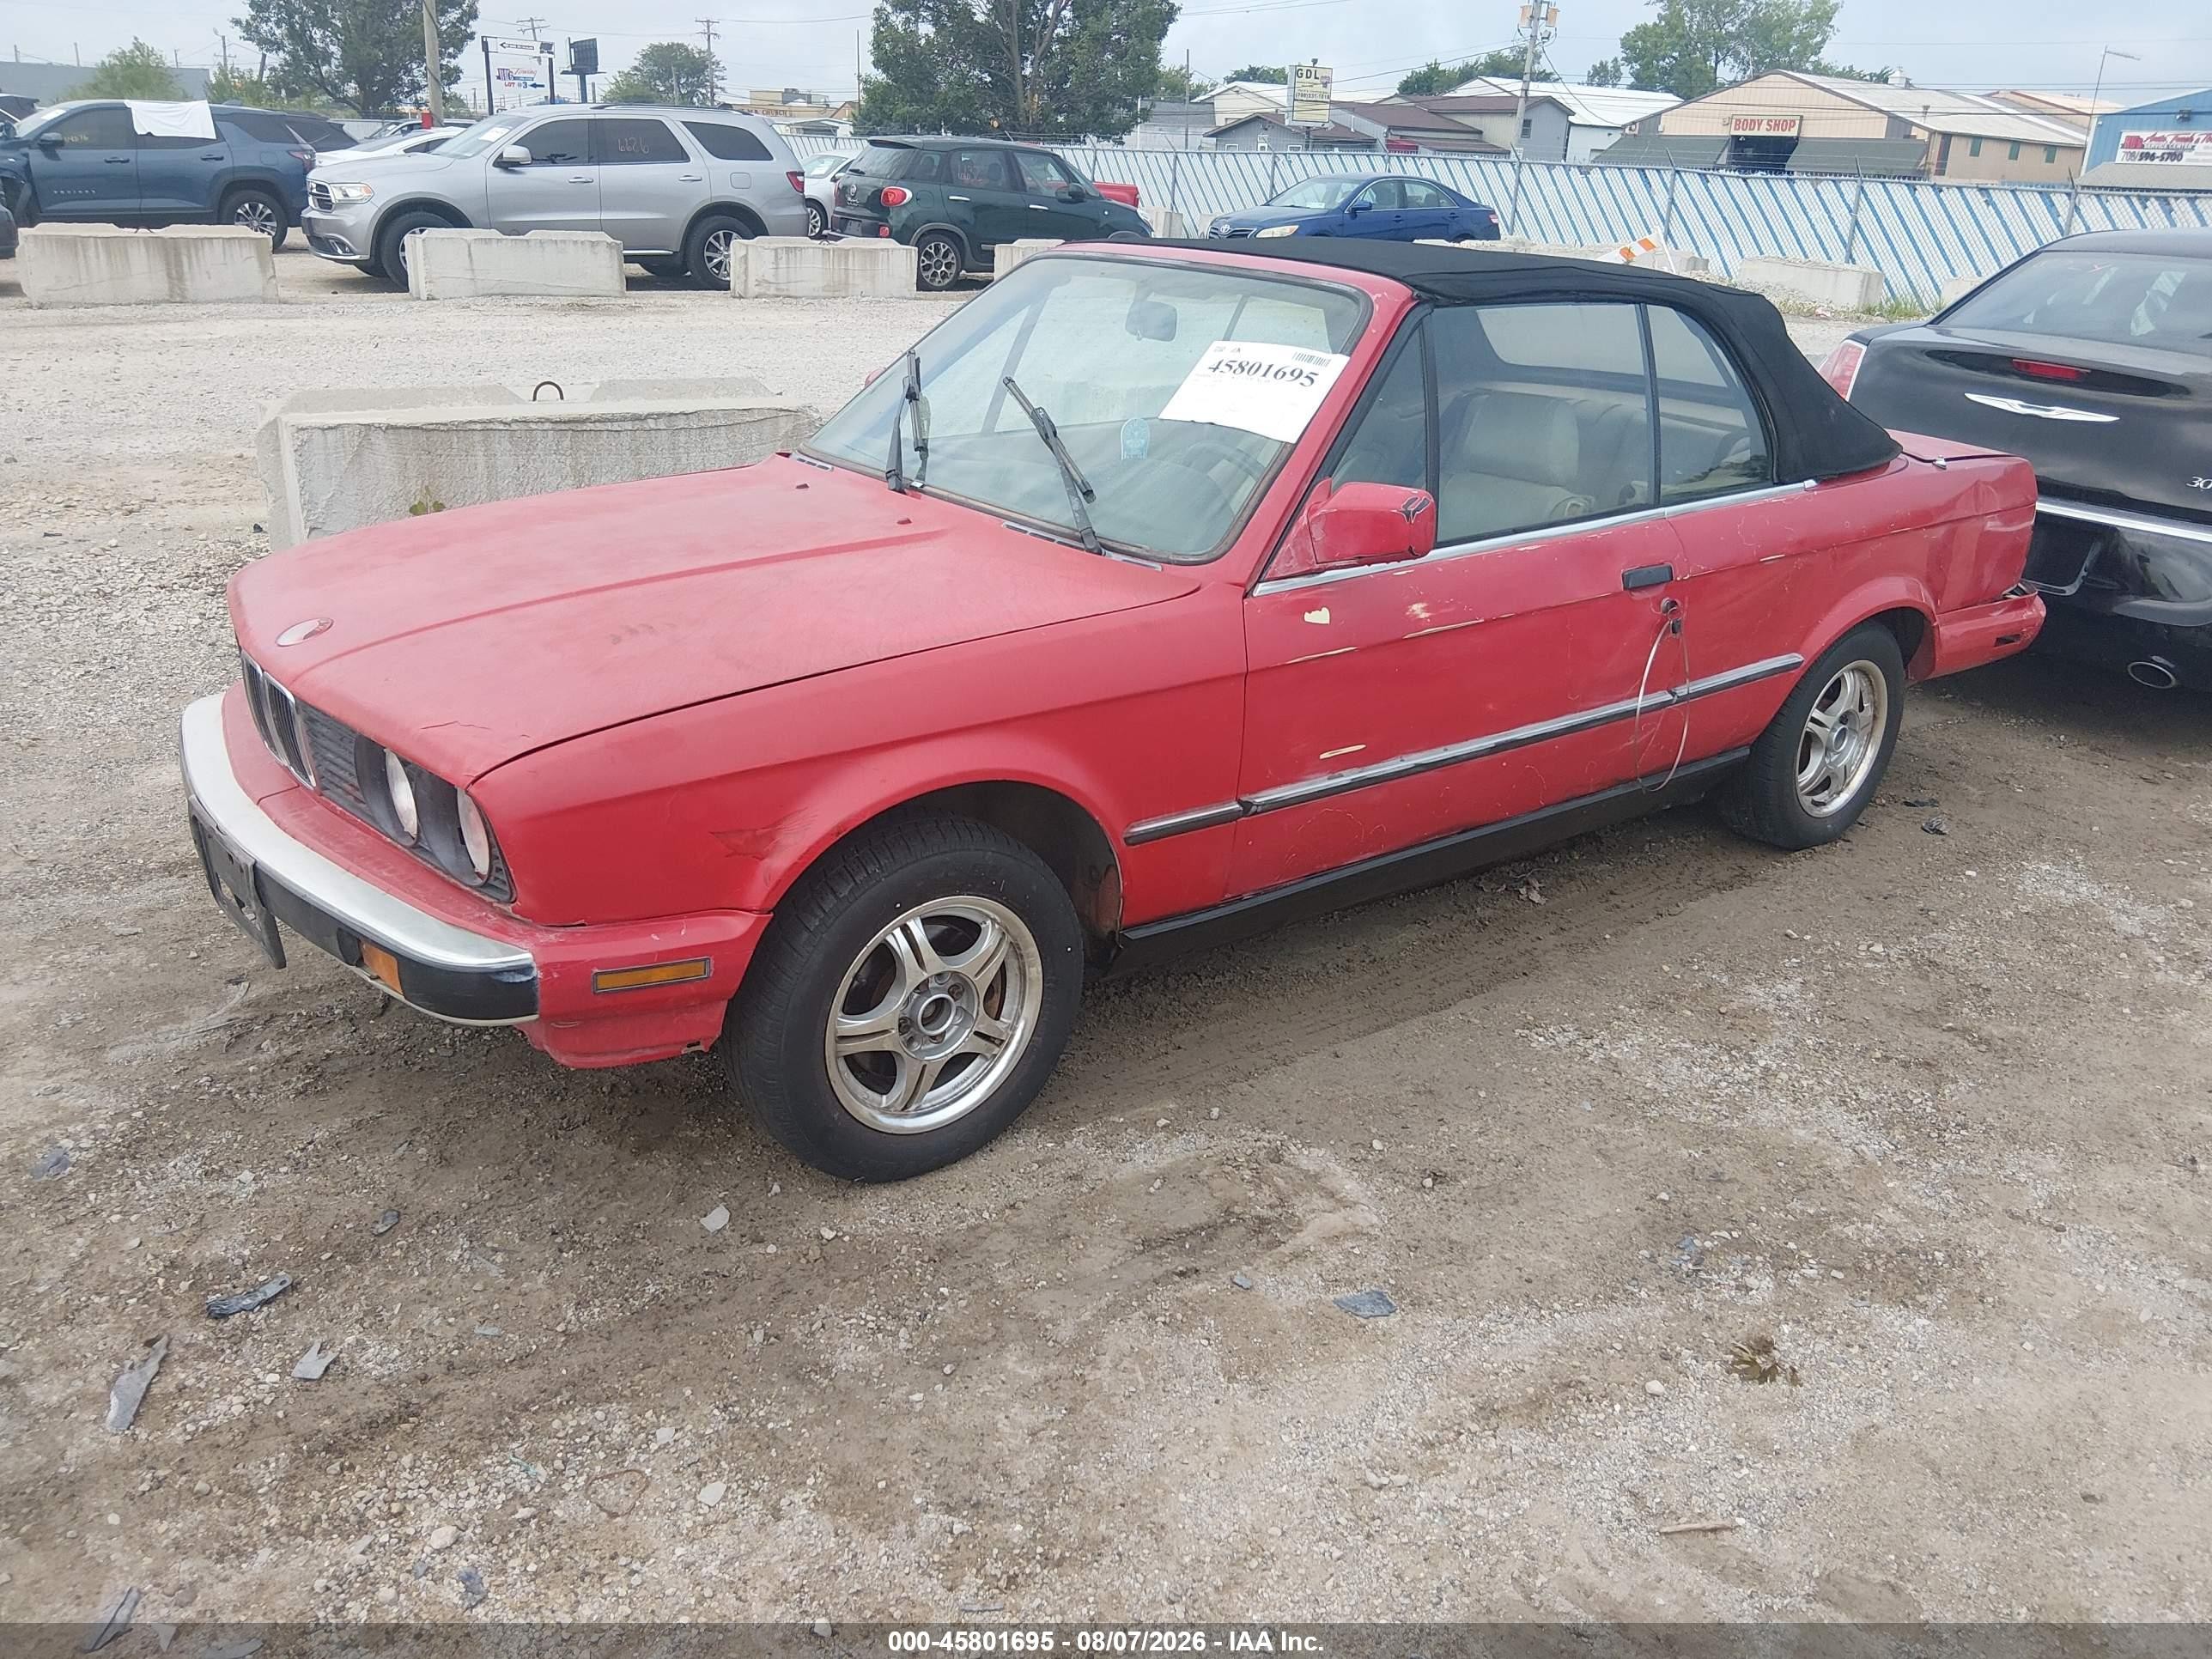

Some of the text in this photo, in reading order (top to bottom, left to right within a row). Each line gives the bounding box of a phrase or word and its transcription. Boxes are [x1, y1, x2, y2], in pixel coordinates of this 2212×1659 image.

[1296, 68, 1320, 80] GDL
[1734, 118, 1796, 132] BODY SHOP
[1208, 358, 1320, 387] 45801695
